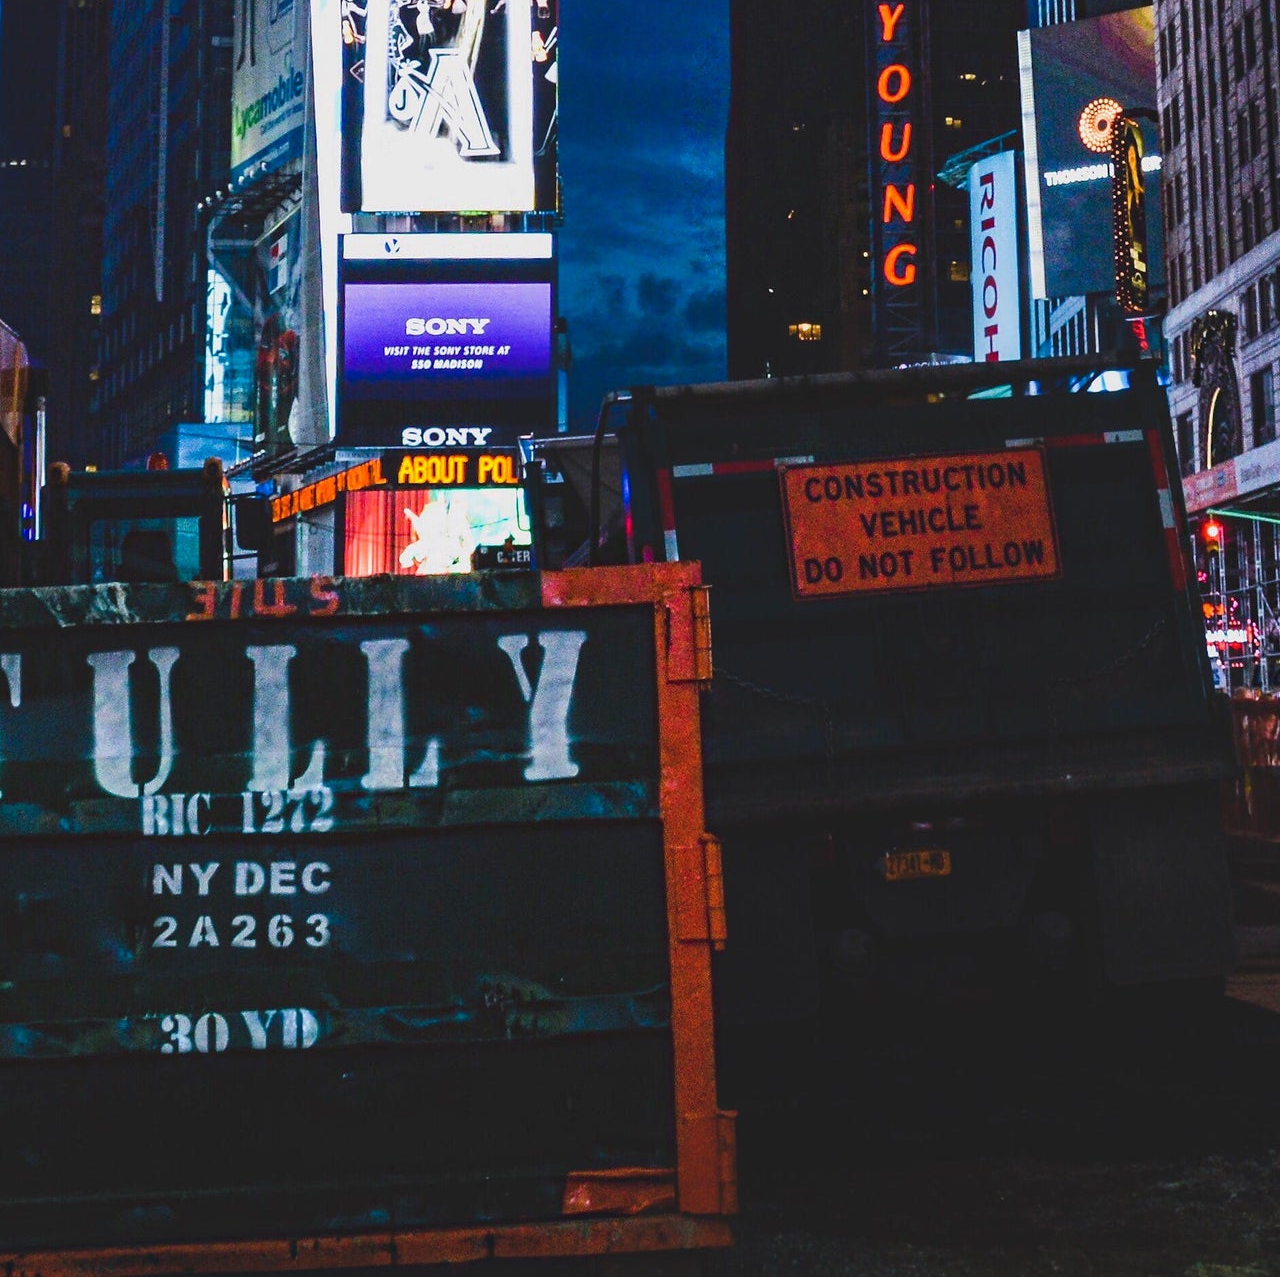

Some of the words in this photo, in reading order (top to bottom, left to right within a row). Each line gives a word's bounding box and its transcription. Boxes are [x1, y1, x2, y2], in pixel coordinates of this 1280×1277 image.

[234, 69, 304, 141] Lycamobile
[877, 3, 918, 287] YOUNG
[1043, 163, 1108, 187] THOMSON
[978, 171, 1001, 362] RICOH
[405, 318, 490, 336] SONY
[384, 346, 410, 357] VISIT
[412, 345, 431, 356] THE
[433, 345, 461, 357] SONY
[463, 345, 495, 356] STORE
[496, 345, 510, 356] AT
[411, 360, 430, 370] 550
[433, 359, 483, 370] MADISON
[402, 427, 492, 447] SONY
[397, 454, 468, 485] ABOUT
[803, 461, 1028, 503] CONSTRUCTION
[860, 503, 981, 539] VEHICLE
[804, 557, 844, 585] DO
[858, 550, 915, 580] NOT
[930, 540, 1046, 575] FOLLOW
[241, 785, 335, 834] 1272
[152, 862, 220, 895] NY
[234, 860, 332, 896] DEC
[152, 912, 332, 948] 2A263
[160, 1012, 229, 1054] 30
[240, 1007, 320, 1050] YD
